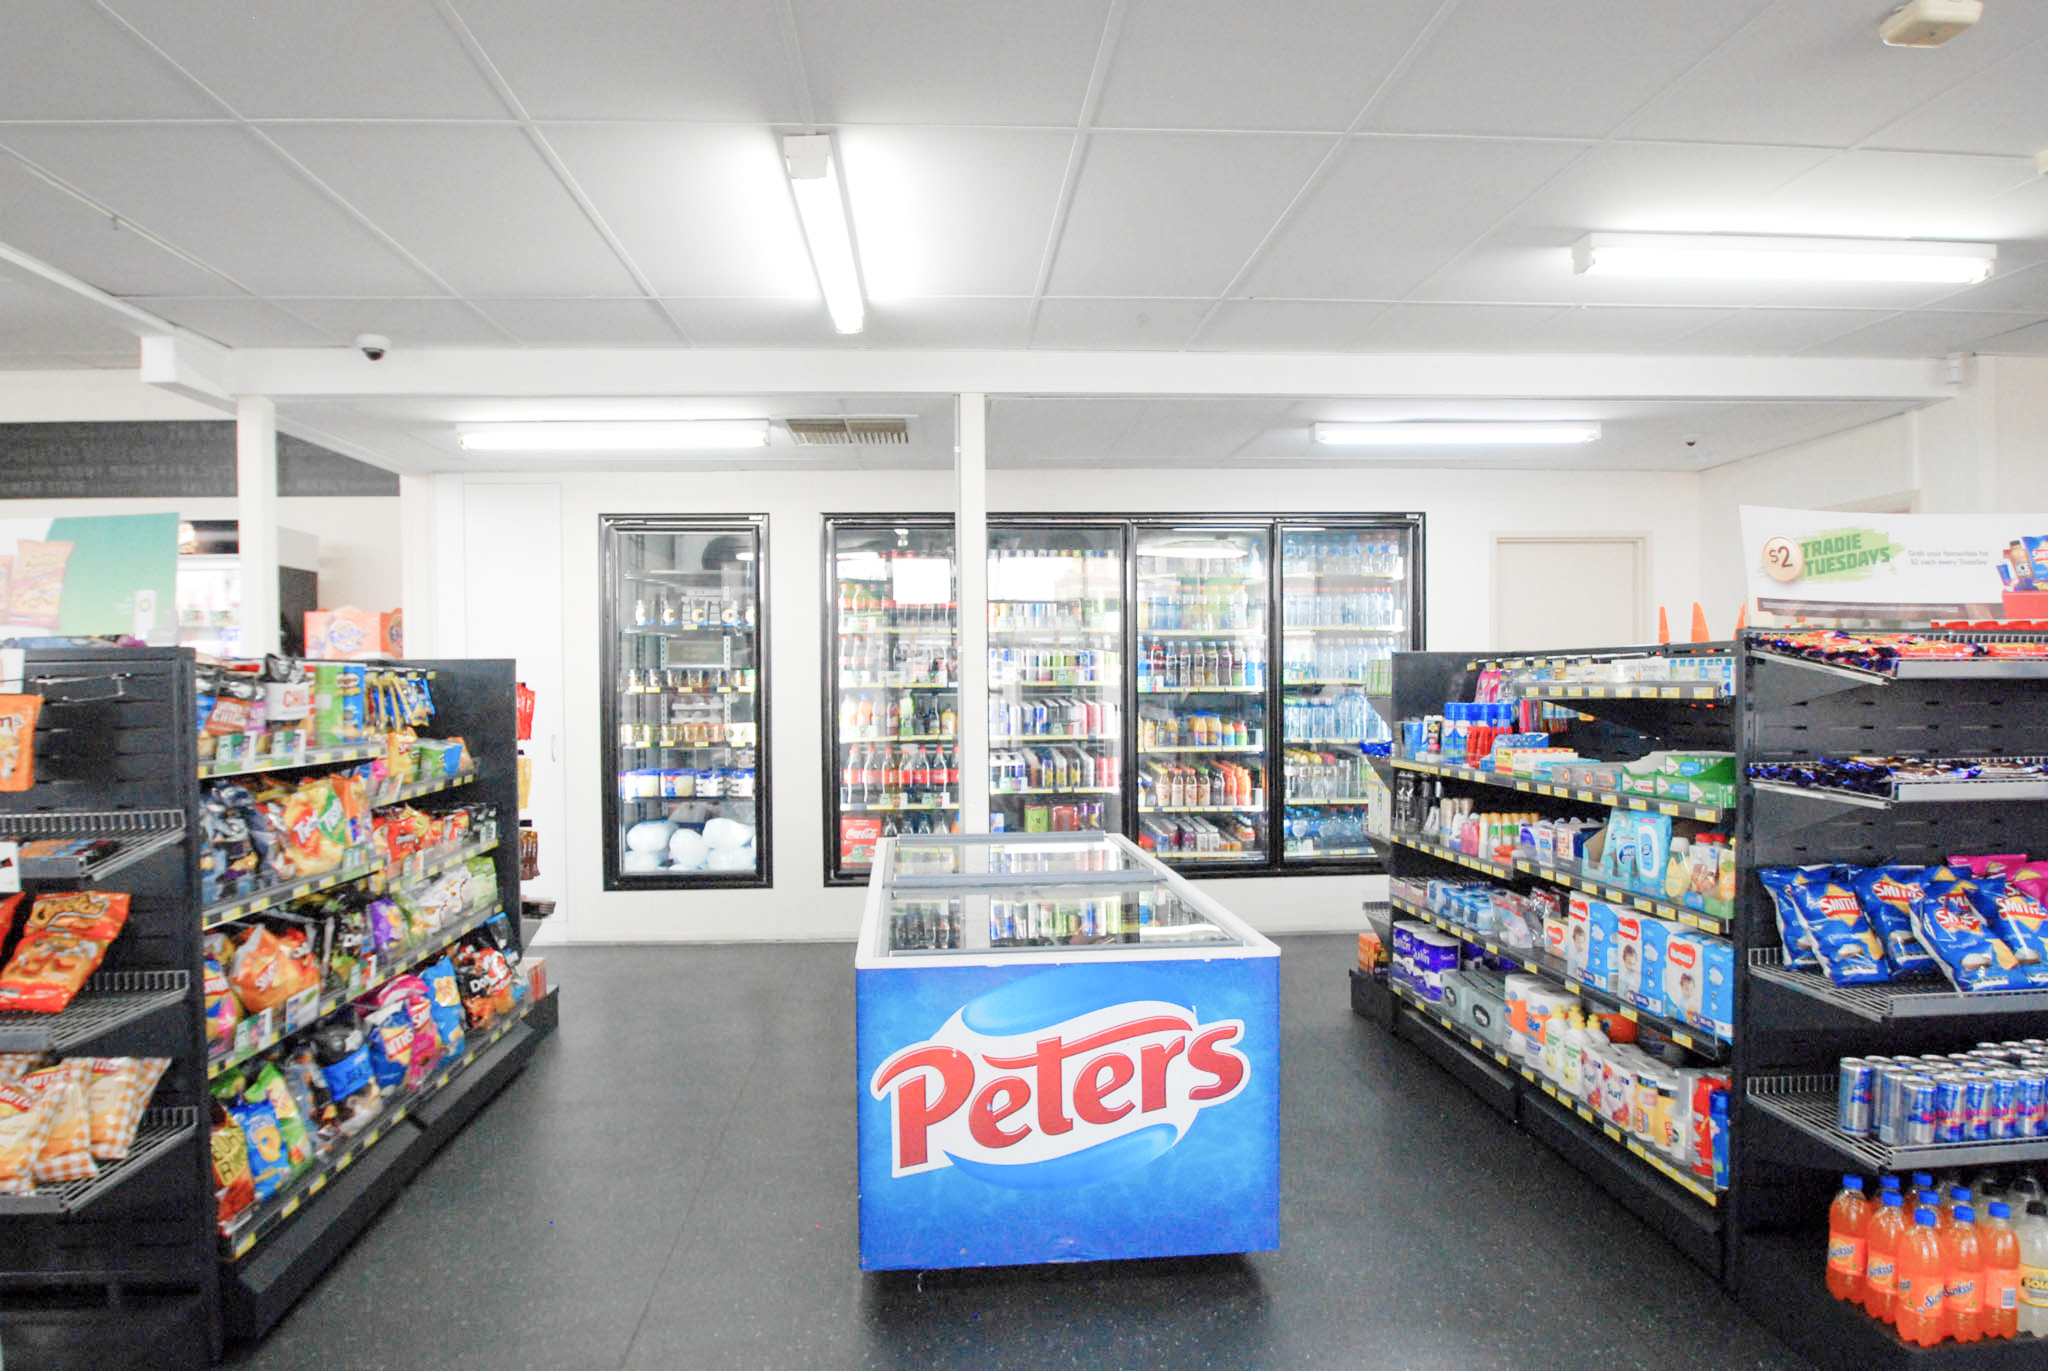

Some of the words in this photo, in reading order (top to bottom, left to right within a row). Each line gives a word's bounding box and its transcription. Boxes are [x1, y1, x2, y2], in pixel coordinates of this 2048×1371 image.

[1769, 546, 1793, 568] $2
[1801, 533, 1862, 559] TRADIE
[1805, 546, 1890, 577] TUESDAYS
[877, 1016, 1244, 1169] Peters
